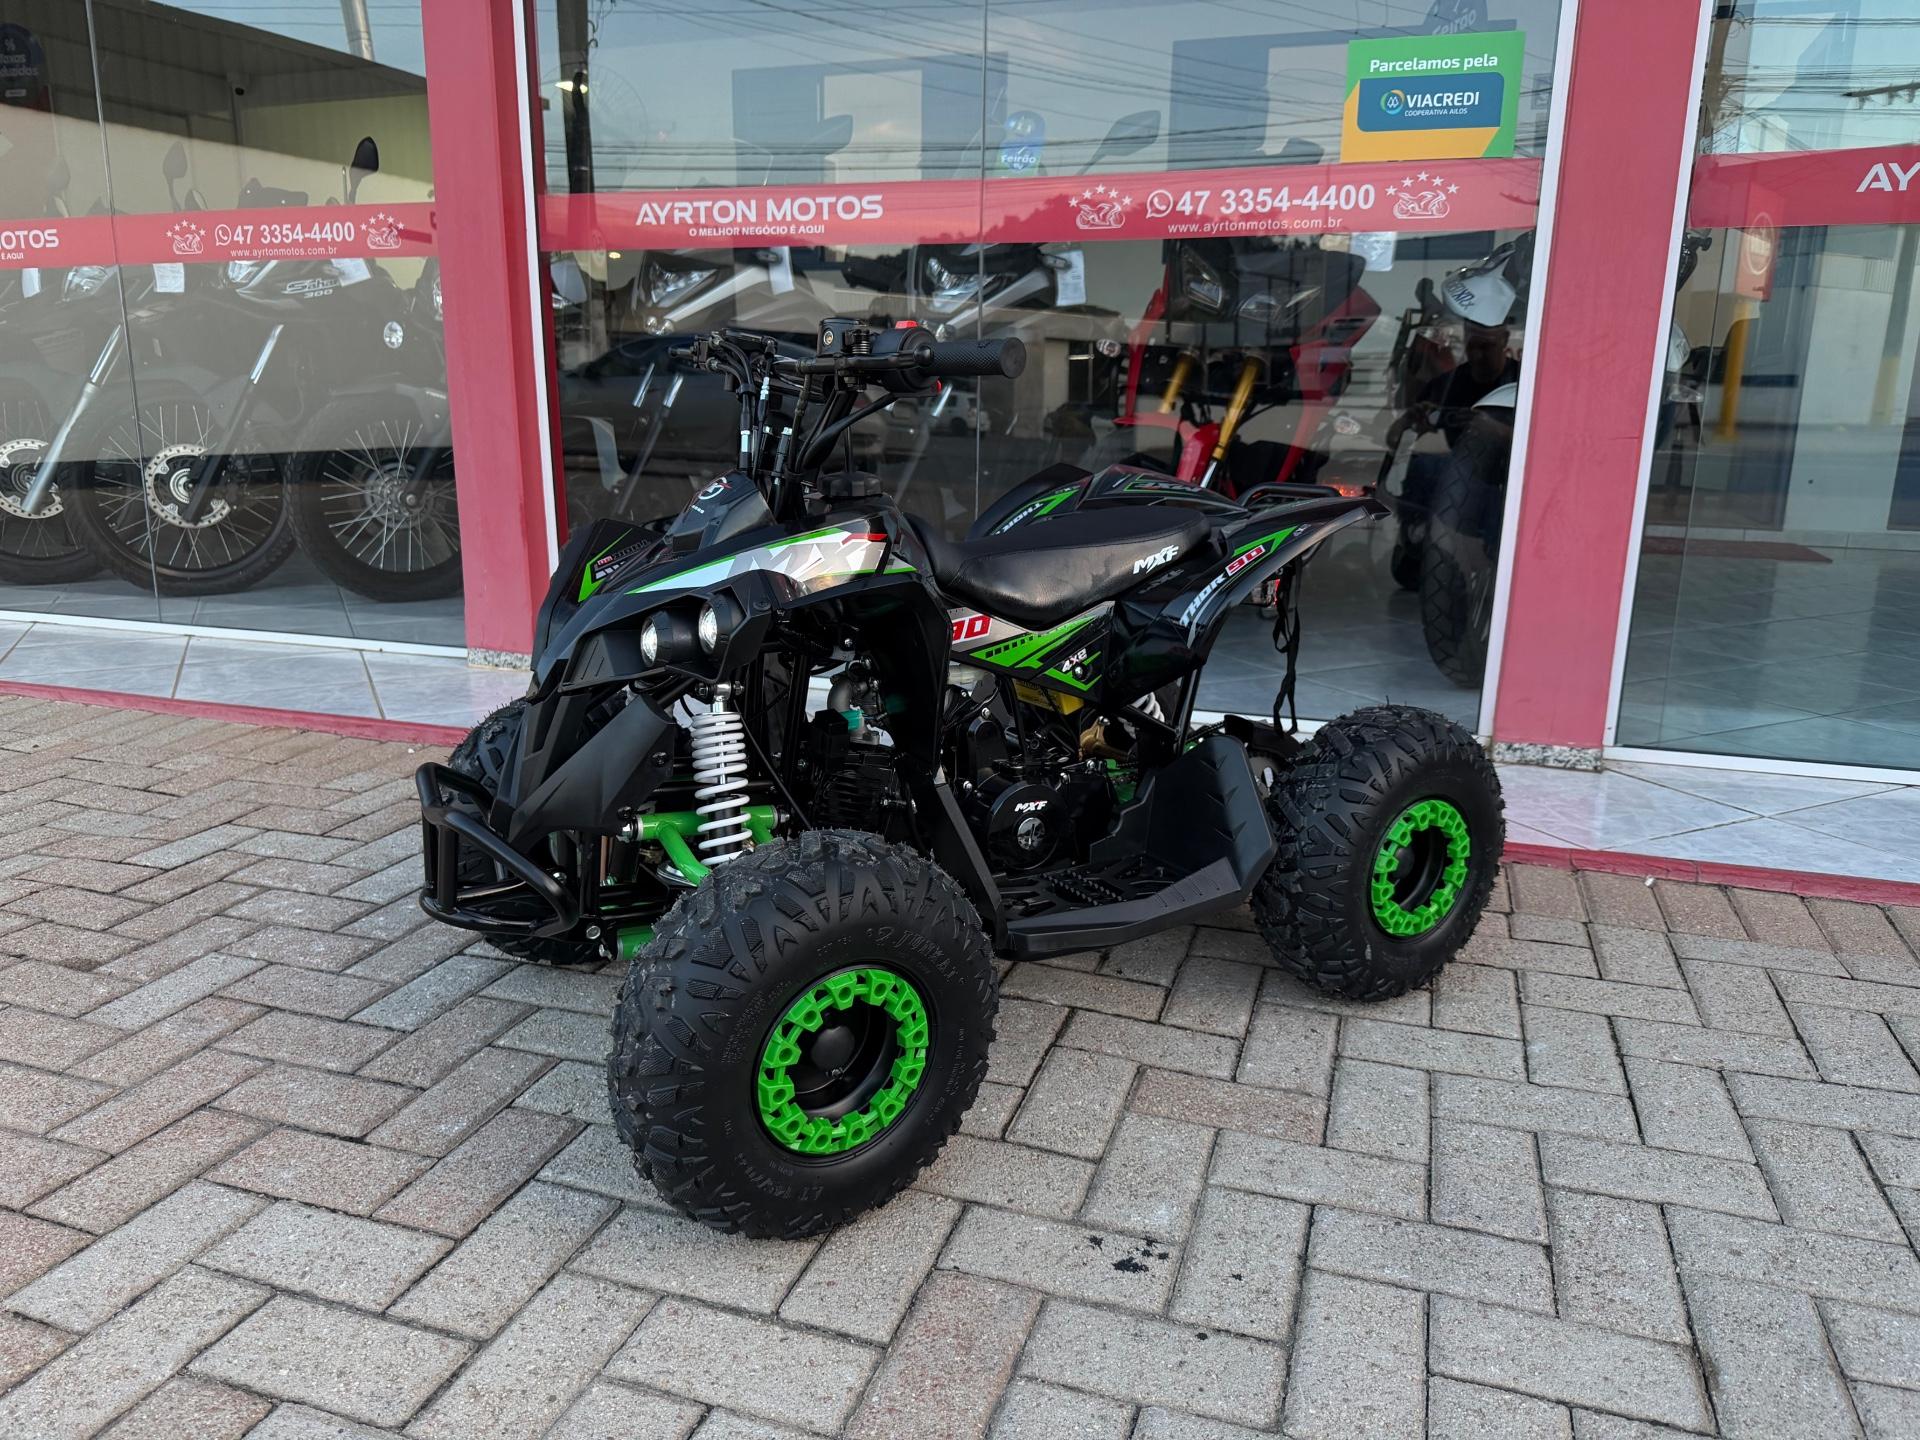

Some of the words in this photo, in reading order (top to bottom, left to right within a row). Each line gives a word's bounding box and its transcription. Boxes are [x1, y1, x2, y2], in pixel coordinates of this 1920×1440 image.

[1369, 57, 1460, 73] Parcelamos
[1463, 54, 1498, 71] pela
[1406, 91, 1480, 108] VIACREDI
[1404, 109, 1449, 117] COOPERATIVA
[1176, 190, 1210, 216] 47
[1220, 184, 1376, 215] 3354-4400
[635, 200, 758, 226] AYRTON
[766, 194, 884, 223] MOTOS
[233, 225, 254, 245] 47
[260, 221, 355, 244] 3354-4400
[688, 228, 697, 237] O
[699, 227, 741, 237] MELHOR
[742, 224, 788, 235] NEGÓCIO
[799, 225, 825, 235] AQUI
[1167, 217, 1343, 234] www.ayrtonmotos.com.br
[0, 228, 60, 250] OTOS
[230, 245, 337, 258] www.ayrtonmotos.com.br
[303, 288, 334, 299] 300
[1132, 544, 1180, 575] MXF
[1179, 572, 1228, 628] THOR
[1226, 545, 1265, 576] 90
[1061, 648, 1088, 673] 4X2
[1014, 800, 1048, 813] MXF
